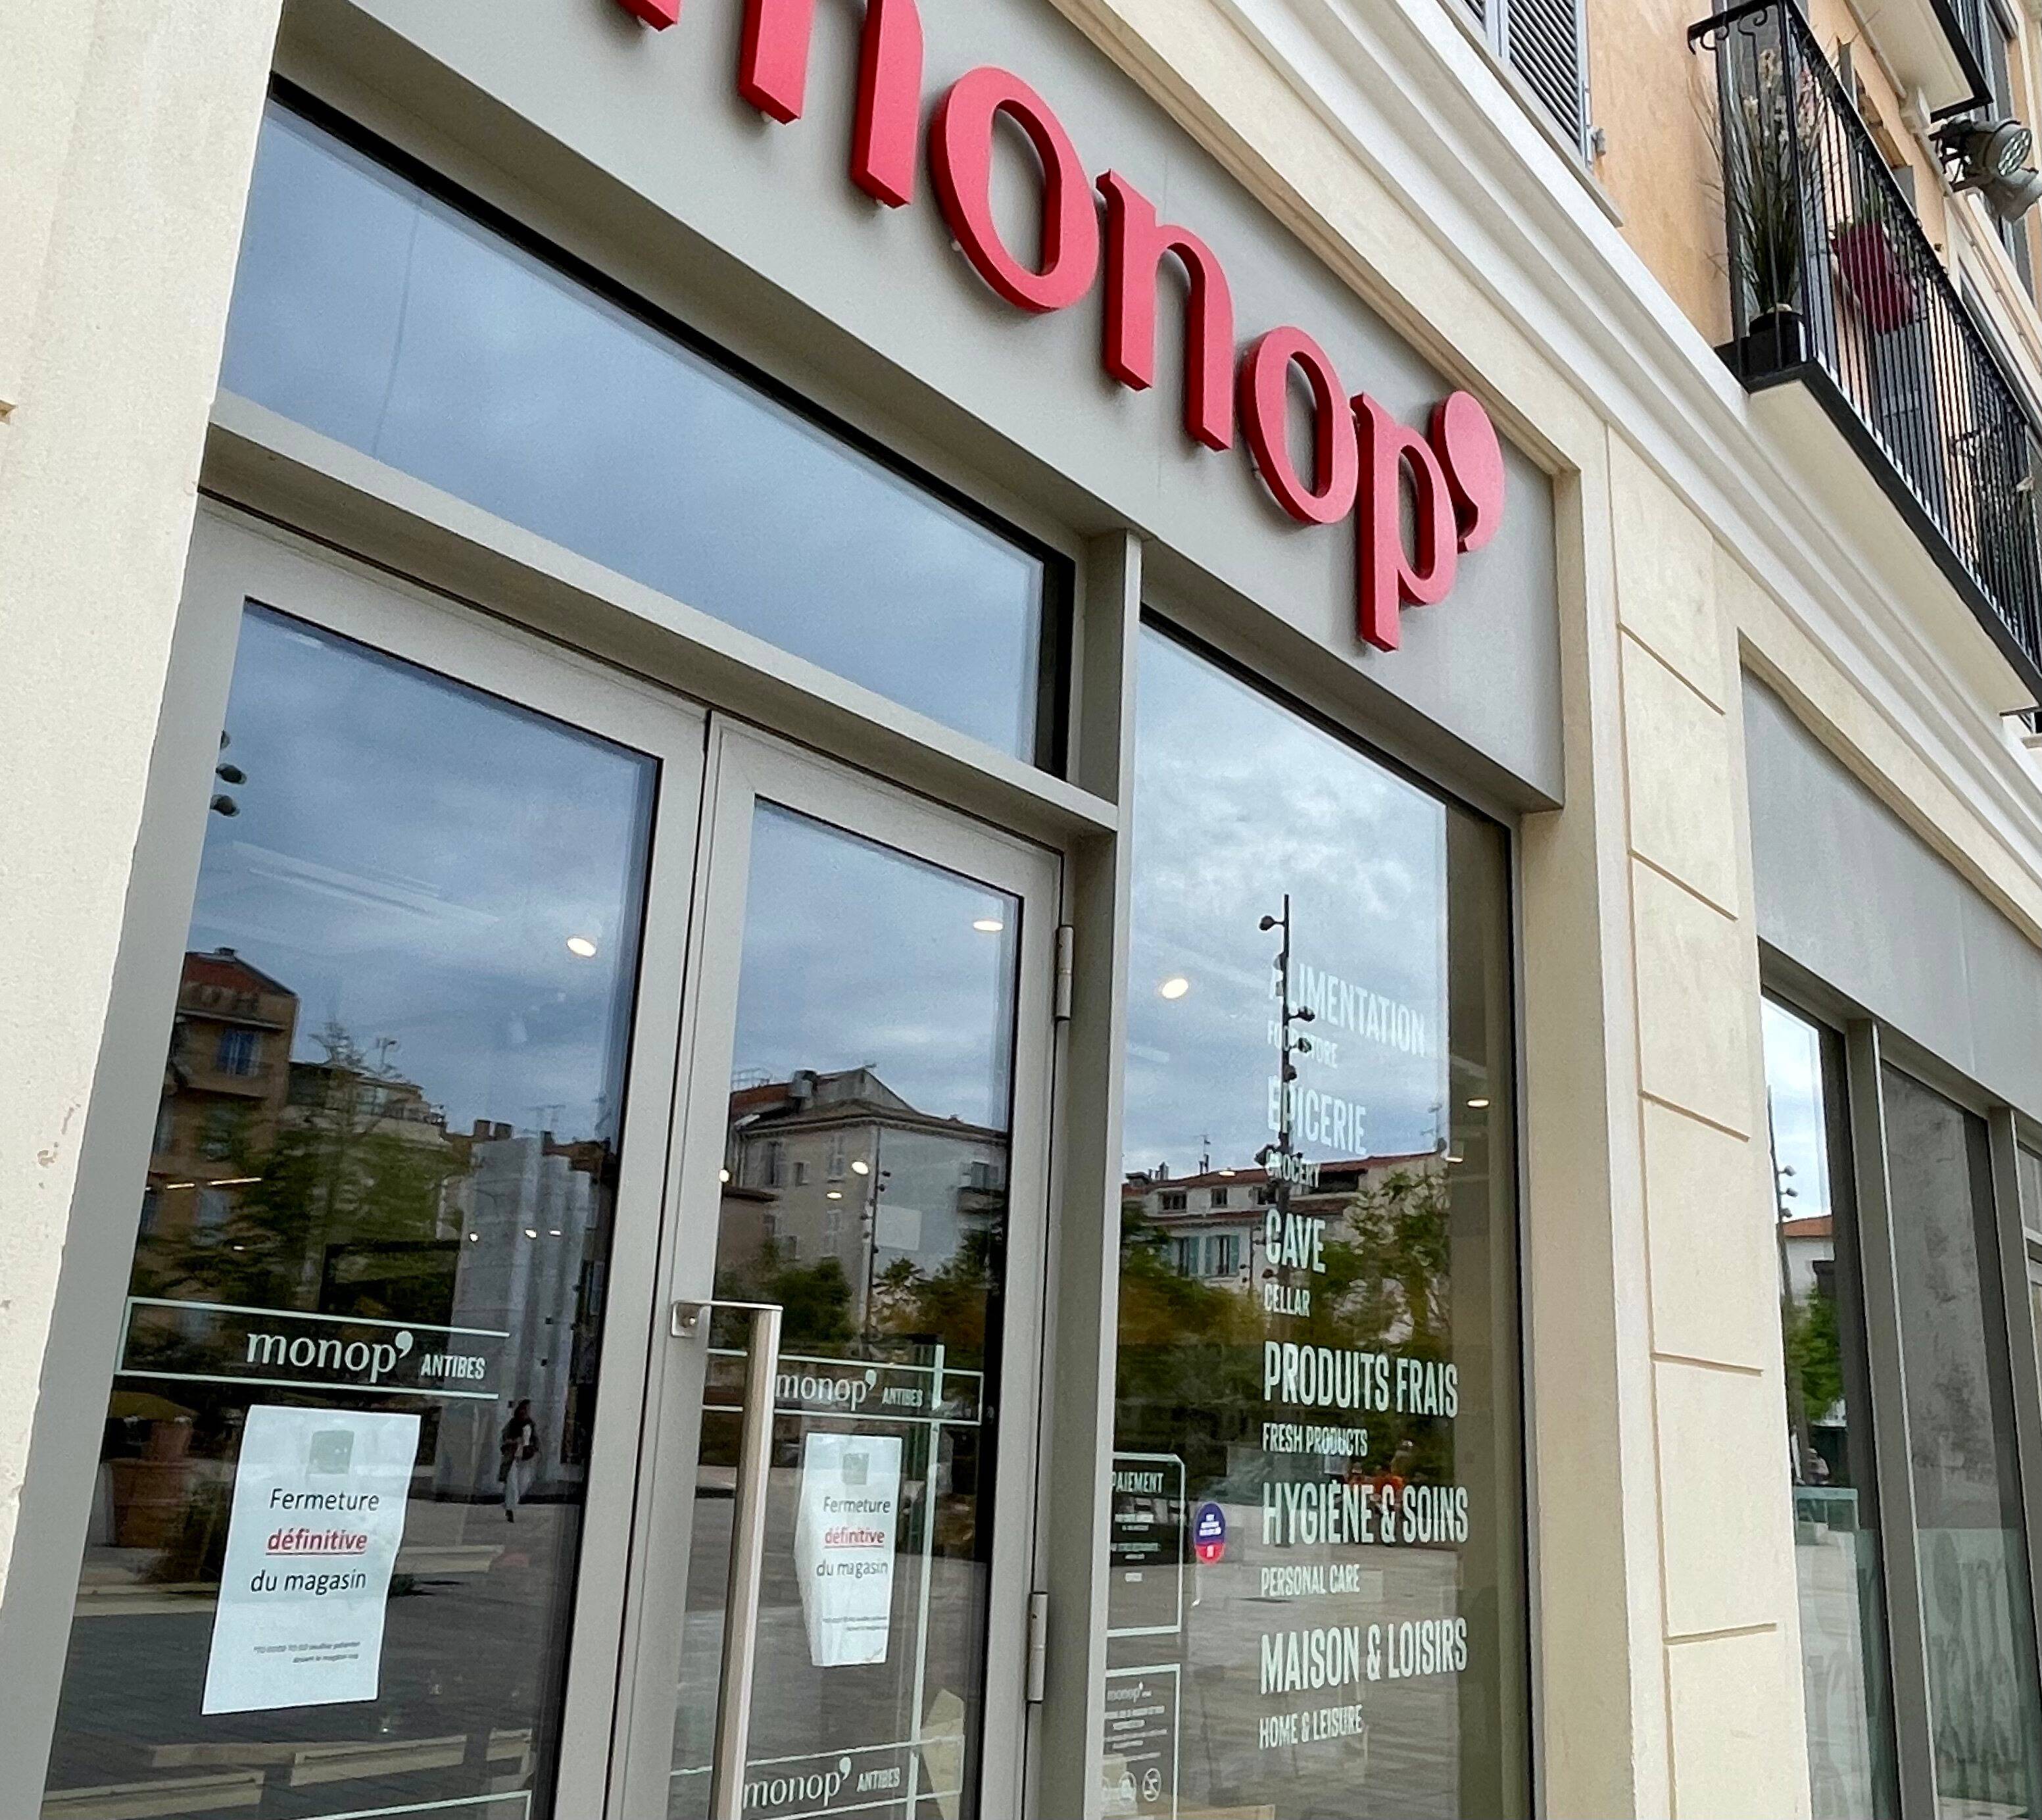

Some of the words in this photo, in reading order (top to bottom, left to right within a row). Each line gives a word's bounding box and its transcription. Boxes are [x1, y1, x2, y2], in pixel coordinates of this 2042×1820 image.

[1265, 1208, 1326, 1273] CAVE
[1264, 1283, 1310, 1317] CELLAR
[421, 1354, 486, 1381] ANTIBES
[1264, 1340, 1390, 1412] PRODUITS
[1396, 1357, 1459, 1418] FRAIS
[1262, 1423, 1305, 1452] FRESH
[1305, 1426, 1369, 1457] PRODUCTS
[269, 1488, 379, 1512] Fermeture
[822, 1496, 891, 1513] Fermeture
[1262, 1480, 1374, 1545] HYGIÈNE
[1380, 1485, 1396, 1544] &
[1402, 1485, 1469, 1544] SOINS
[266, 1528, 368, 1552] définitive
[825, 1526, 885, 1544] définitive
[250, 1569, 277, 1592] du
[283, 1569, 366, 1595] magasin
[815, 1558, 833, 1577] du
[837, 1560, 888, 1579] magasin
[1261, 1565, 1326, 1597] PERSONAL
[1330, 1563, 1361, 1594] CARE
[1260, 1625, 1359, 1694] MAISON
[1367, 1624, 1381, 1681] &
[1387, 1617, 1468, 1679] LOISIRS
[1258, 1713, 1298, 1750] HOME
[1301, 1711, 1310, 1743] &
[1313, 1704, 1363, 1741] LEISURE
